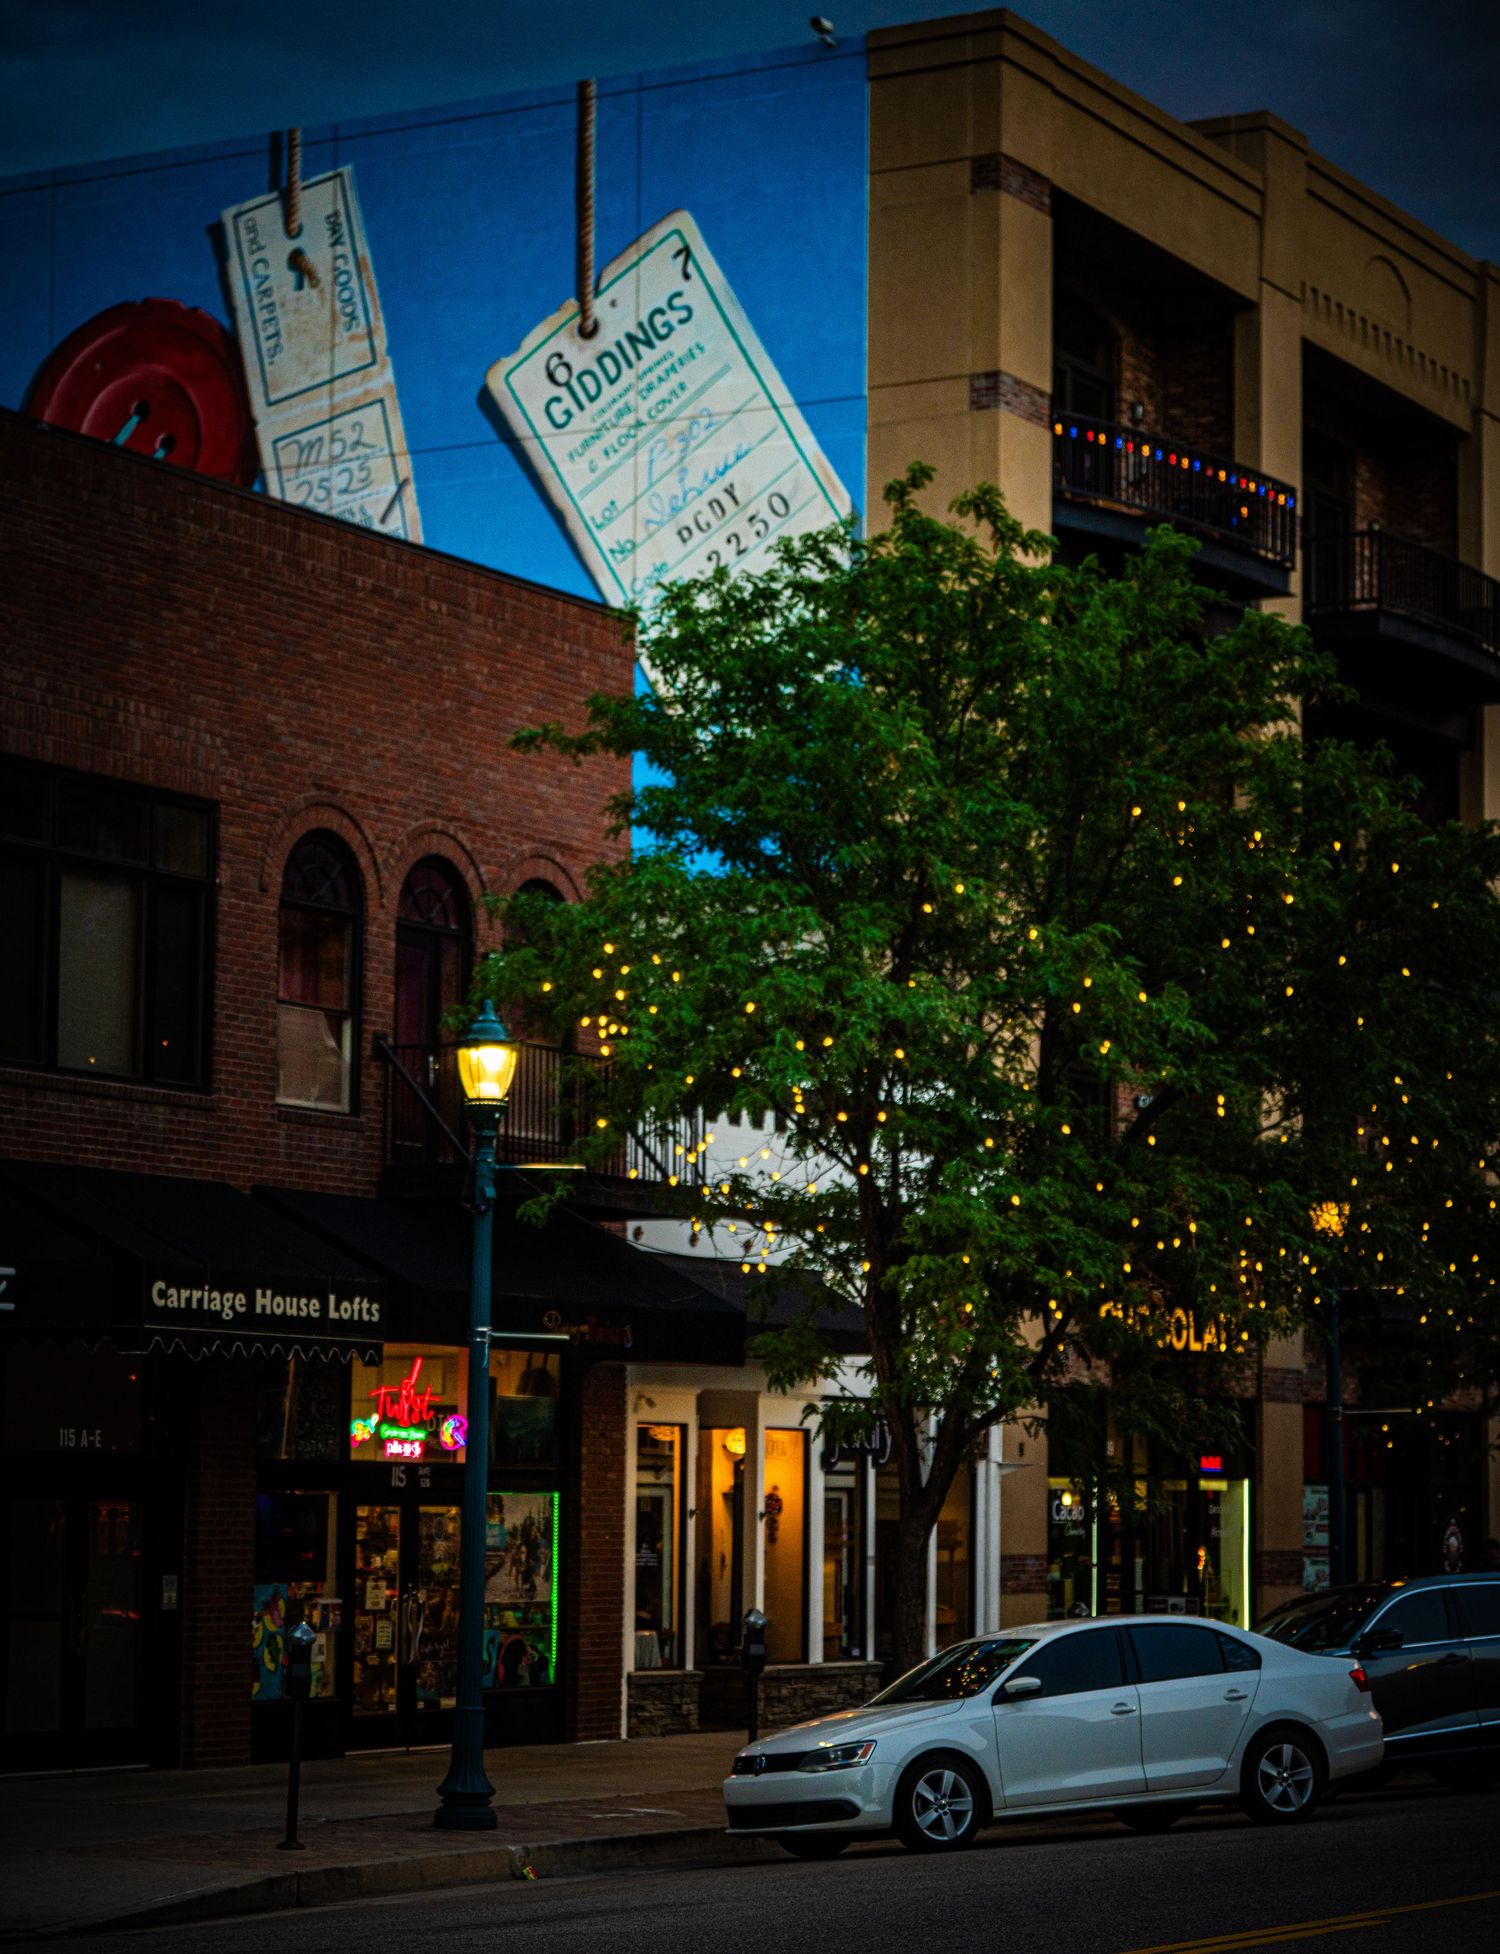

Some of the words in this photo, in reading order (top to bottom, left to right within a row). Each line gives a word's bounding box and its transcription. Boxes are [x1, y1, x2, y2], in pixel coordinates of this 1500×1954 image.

[244, 217, 266, 255] and
[325, 210, 345, 248] DRY
[334, 253, 360, 332] GOODS
[544, 291, 693, 430] GIDDINGS
[545, 352, 572, 387] 6
[638, 341, 705, 401] DRAPERIES
[603, 417, 646, 459] FLOOR
[647, 381, 688, 420] COVER
[705, 491, 791, 569] 2250
[151, 1280, 247, 1320] Carriage
[255, 1288, 320, 1318] House
[328, 1293, 381, 1322] Lofts
[58, 1428, 76, 1448] 115
[81, 1430, 103, 1449] A-E
[391, 1466, 407, 1488] 115
[1051, 1498, 1085, 1521] Cacao
